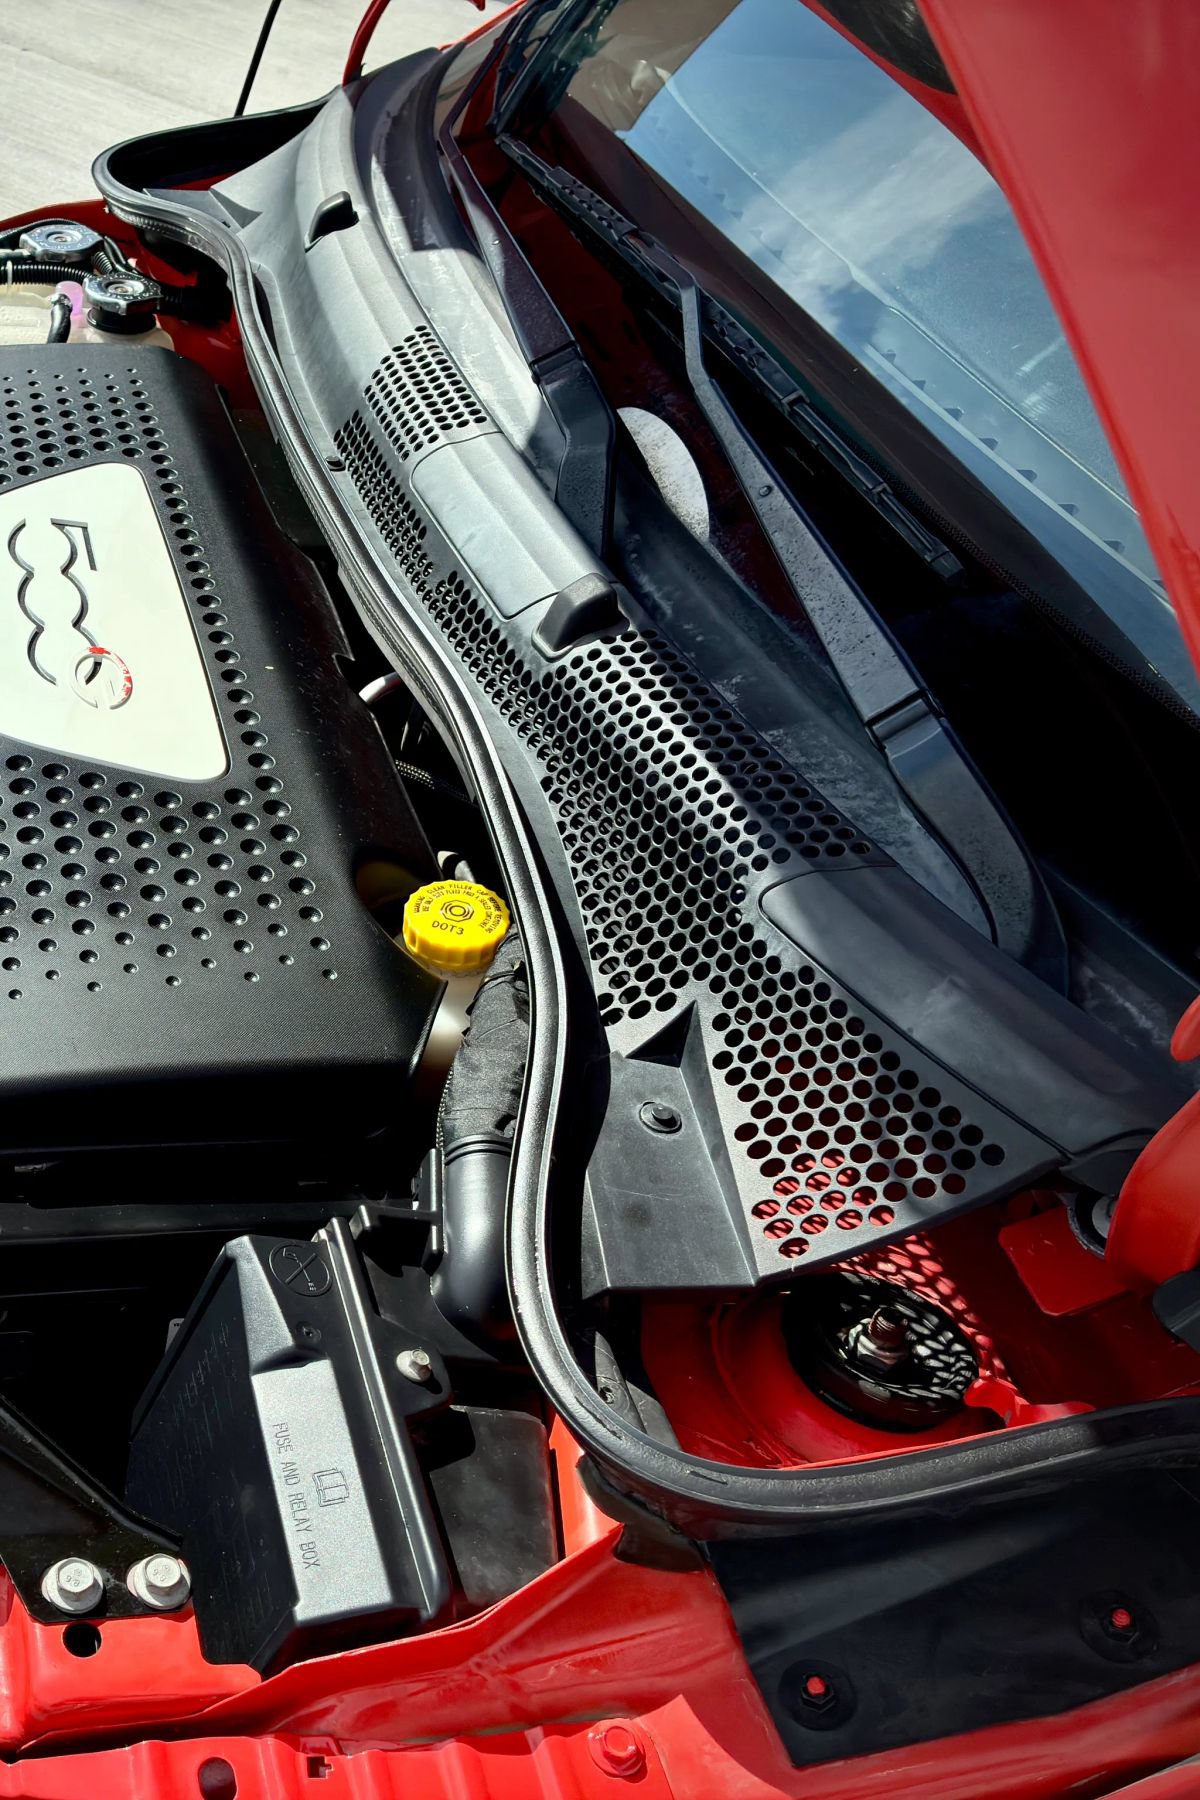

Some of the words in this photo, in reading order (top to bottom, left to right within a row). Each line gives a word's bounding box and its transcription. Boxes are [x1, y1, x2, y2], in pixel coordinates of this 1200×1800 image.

[427, 885, 445, 894] CLEAN
[431, 920, 464, 935] DOT3
[272, 1422, 293, 1455] FUSE
[281, 1461, 300, 1486] AND
[288, 1492, 312, 1532] RELAY
[299, 1541, 320, 1569] BOX
